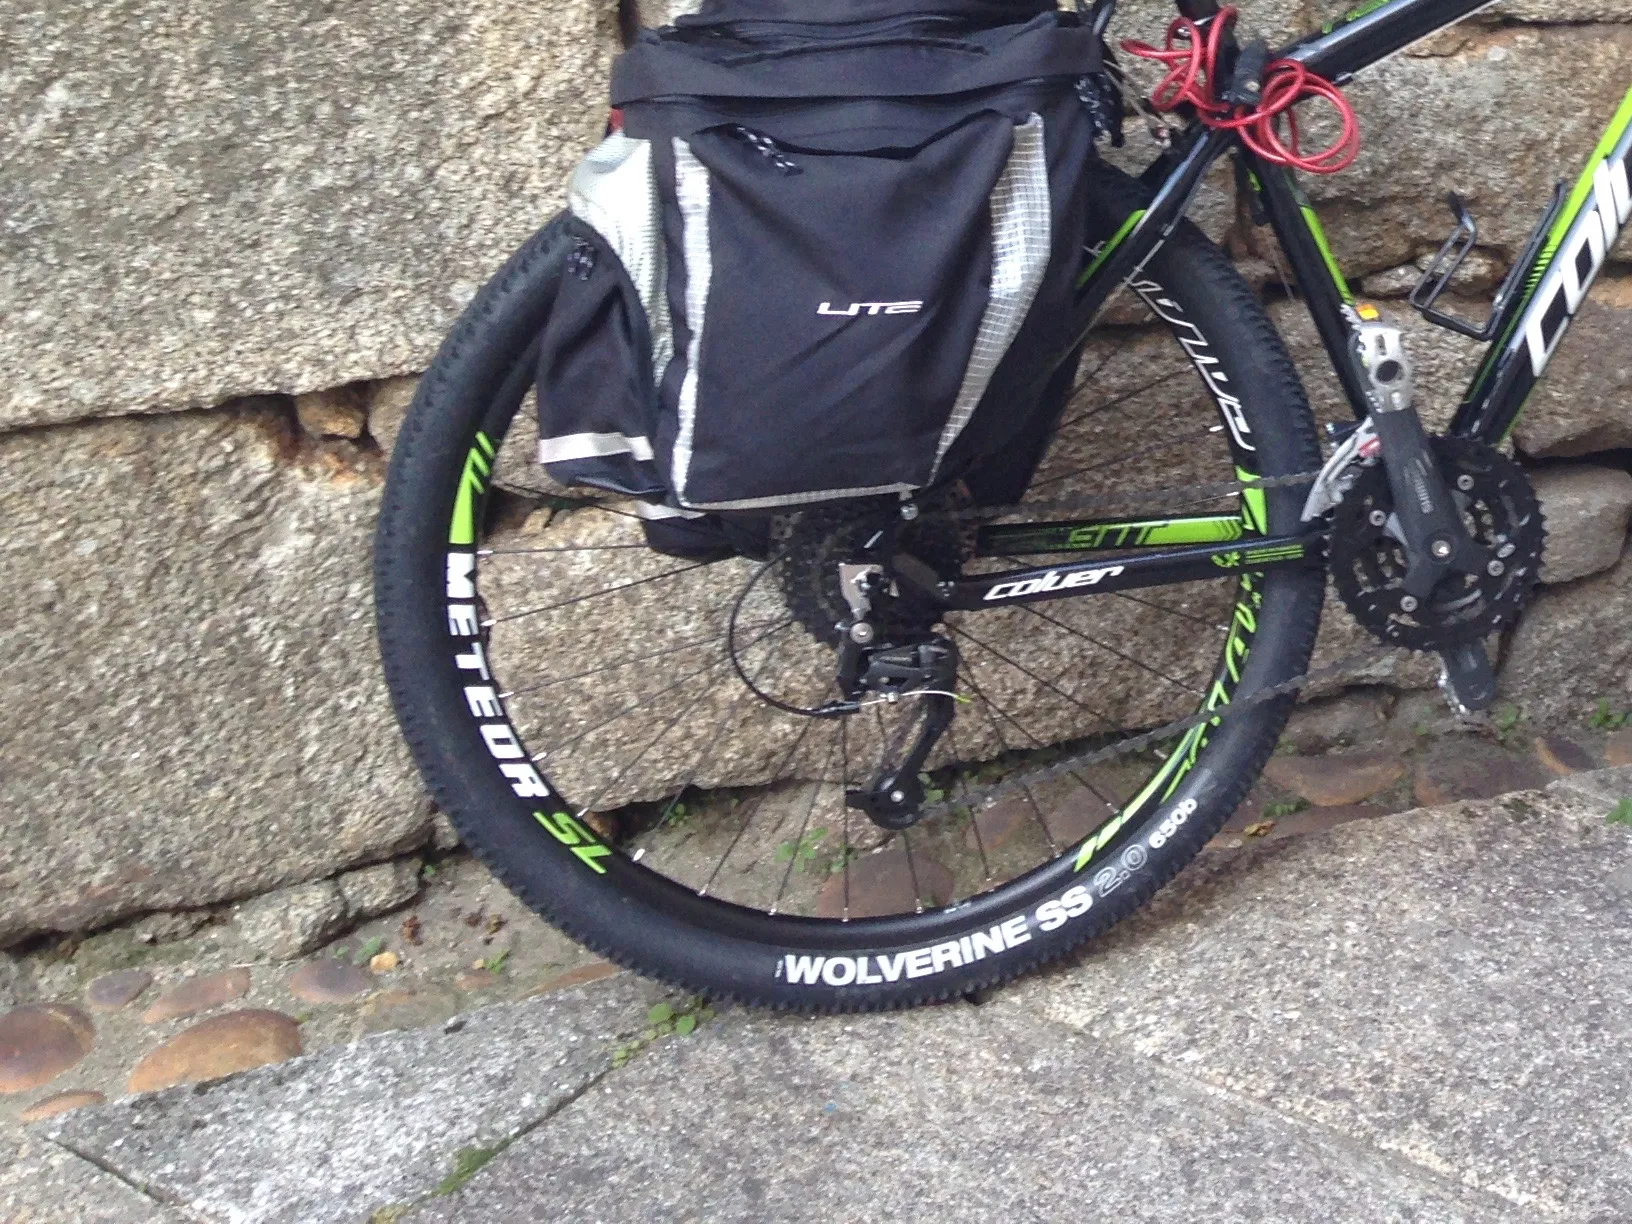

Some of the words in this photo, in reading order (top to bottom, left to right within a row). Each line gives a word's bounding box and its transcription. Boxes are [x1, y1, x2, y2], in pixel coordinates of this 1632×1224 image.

[446, 552, 550, 798] METEOR
[532, 810, 614, 875] SL
[783, 914, 1032, 986] WOLVERINE
[1036, 885, 1093, 932] SS
[1093, 843, 1148, 898] 2.0
[1148, 797, 1198, 849] 650b
